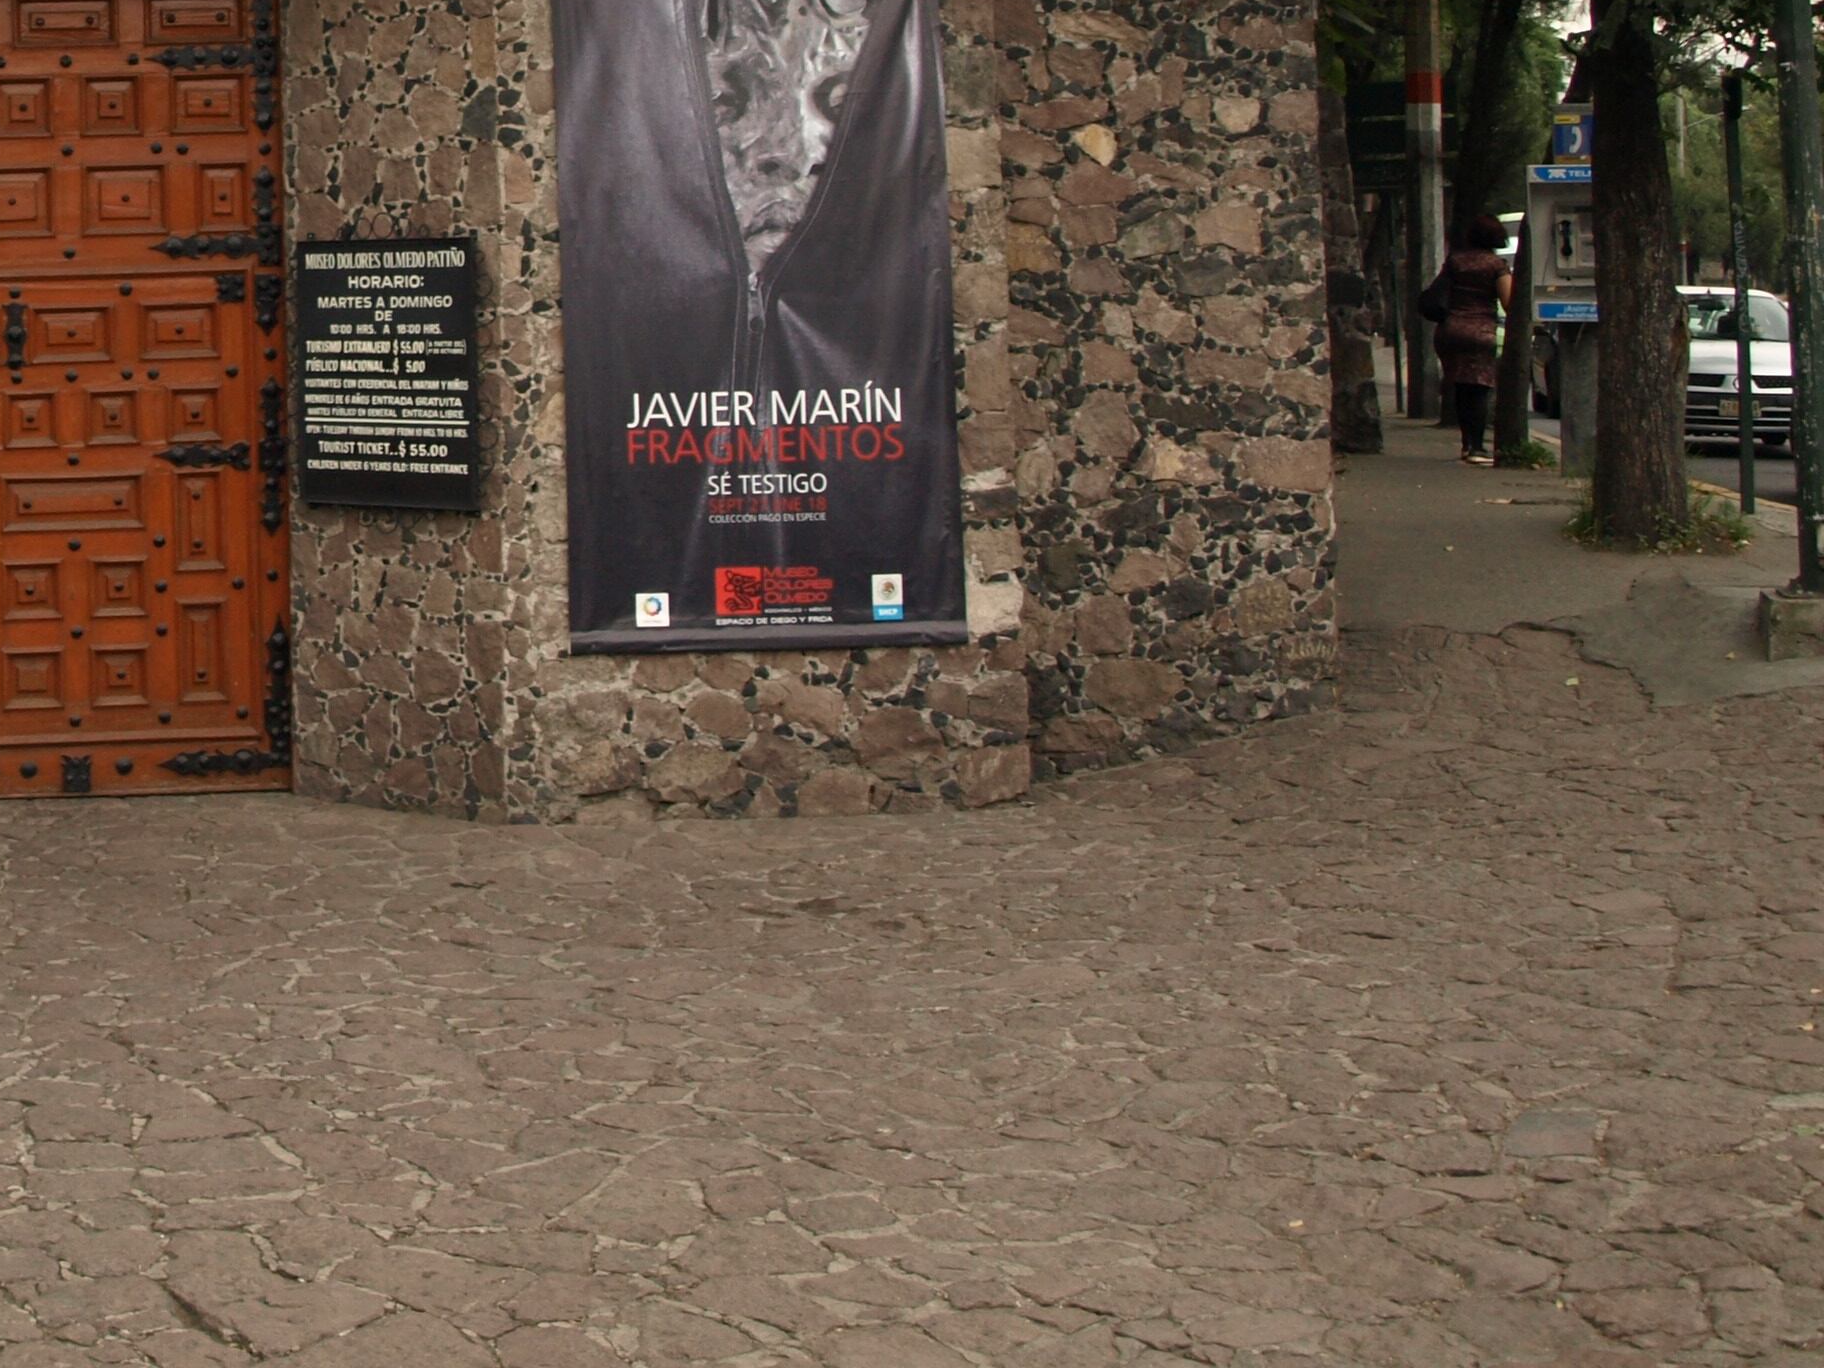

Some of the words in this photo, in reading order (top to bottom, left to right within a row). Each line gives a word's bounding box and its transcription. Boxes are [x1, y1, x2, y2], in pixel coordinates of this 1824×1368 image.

[305, 252, 335, 270] MUSEO
[337, 252, 381, 269] DOLORES
[383, 251, 425, 268] OLMEDO
[427, 246, 465, 267] PATIÑO
[347, 274, 424, 289] HORARIO:
[317, 296, 372, 309] MARTES
[376, 296, 385, 308] A
[389, 295, 453, 308] DOMINGO
[374, 310, 393, 322] DE
[382, 324, 390, 334] A
[306, 340, 342, 354] TURISMO
[344, 340, 391, 353] EXTRANJERO
[306, 357, 338, 372] PÚBLICO
[371, 395, 413, 406] ENTRADA
[415, 395, 463, 407] GRATUITA
[626, 390, 756, 429] JAVIER
[770, 380, 902, 426] MARÍN
[401, 408, 439, 418] ENTRADA
[318, 440, 355, 454] TOURIST
[626, 423, 905, 465] FRAGMENTOS
[307, 459, 338, 470] CHILDREN
[339, 460, 363, 470] UNDER
[370, 461, 391, 471] YEARS
[410, 462, 429, 473] FREE
[430, 463, 469, 475] ENTRANCE
[707, 472, 732, 495] SÉ
[738, 472, 828, 494] TESTIGO
[708, 514, 756, 524] COLECCIÓN
[758, 513, 781, 522] PAGO
[783, 513, 795, 521] EN
[796, 512, 827, 521] ESPECIE
[763, 566, 818, 578] MUSEO
[763, 578, 833, 590] DOLORES
[764, 591, 828, 603] OLMEDO
[716, 617, 754, 626] ESPACIO
[770, 616, 798, 624] DIEGO
[808, 615, 833, 623] FRIDA
